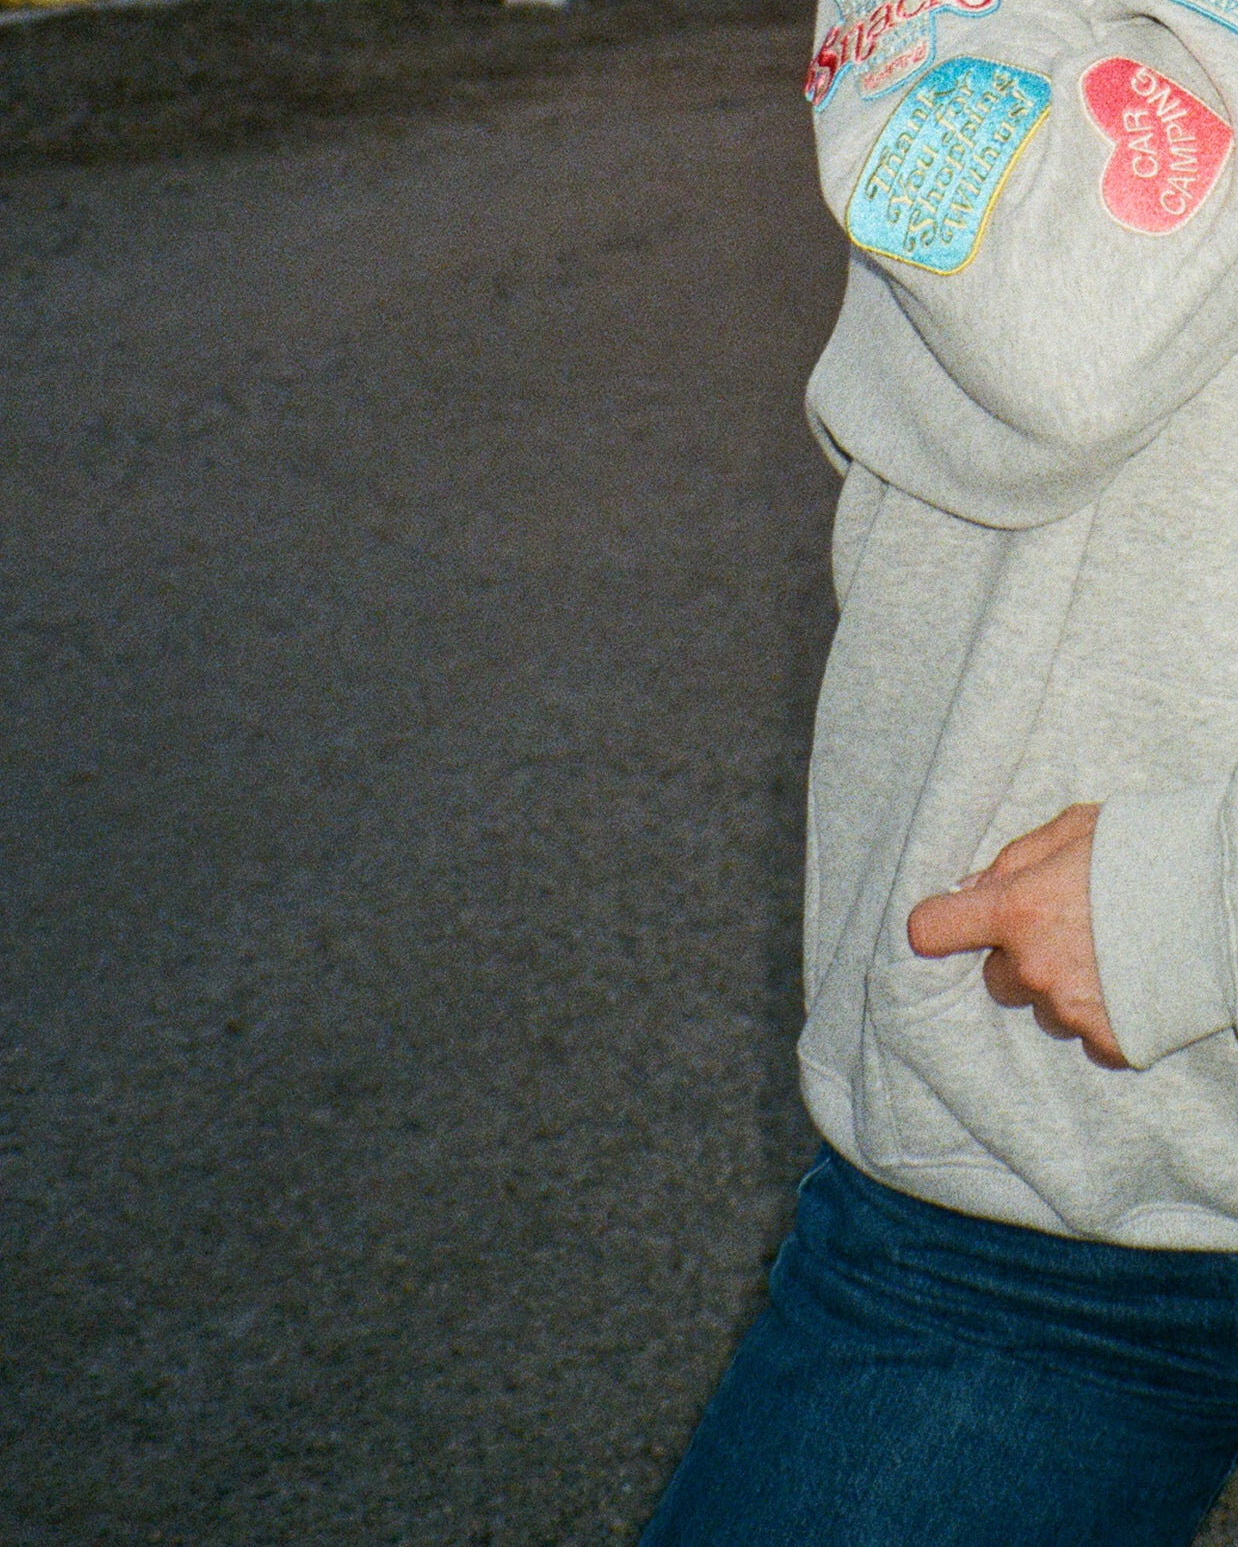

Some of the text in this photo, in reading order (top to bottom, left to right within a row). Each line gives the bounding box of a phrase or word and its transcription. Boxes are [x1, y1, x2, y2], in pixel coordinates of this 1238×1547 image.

[864, 80, 960, 201] Thank
[887, 144, 941, 225] You
[934, 70, 976, 147] for
[902, 71, 1019, 253] Shopping
[940, 145, 1001, 244] With
[1123, 109, 1159, 179] CAR
[1130, 66, 1200, 216] CAMPING
